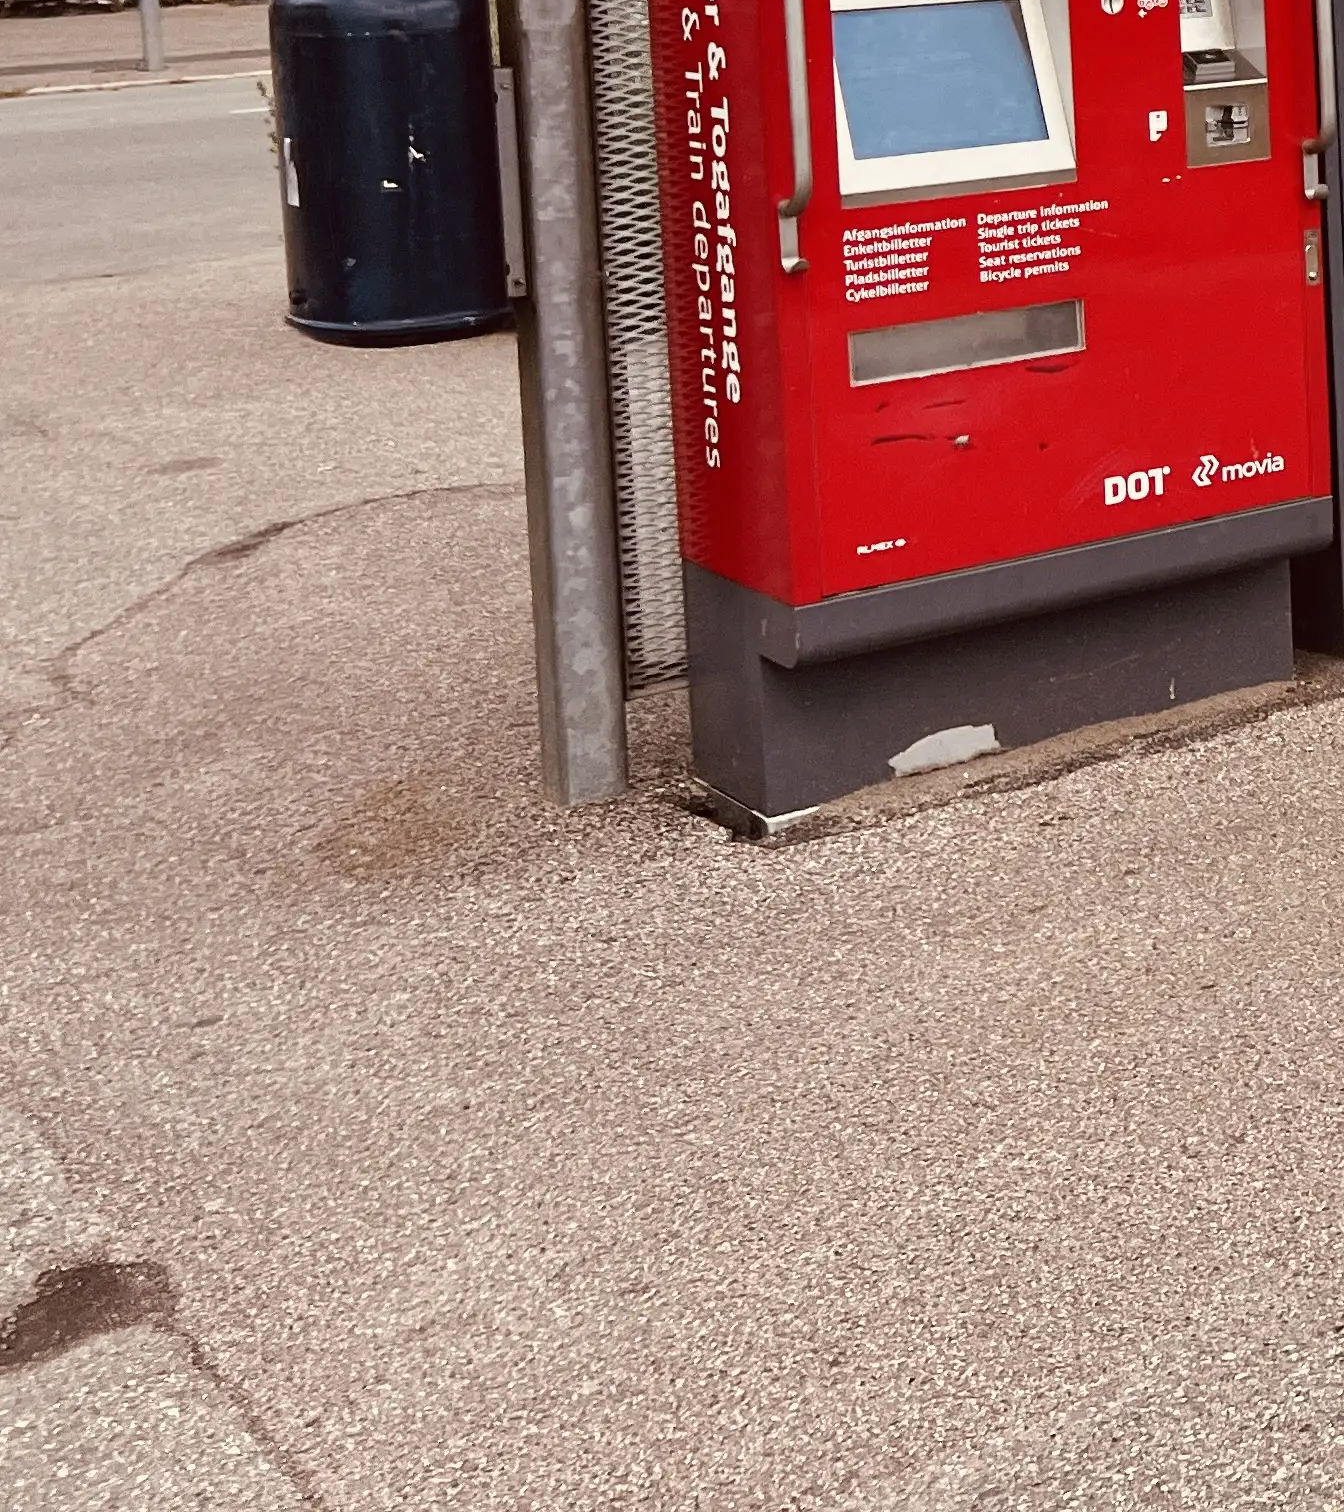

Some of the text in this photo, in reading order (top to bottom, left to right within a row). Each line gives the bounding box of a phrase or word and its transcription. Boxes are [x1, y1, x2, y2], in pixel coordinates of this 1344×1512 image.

[682, 7, 700, 42] &
[708, 42, 726, 81] &
[684, 62, 704, 181] Train
[977, 199, 1109, 228] Departure information
[843, 216, 967, 243] Afgangsinformation
[977, 216, 1080, 240] Single trip tickets
[710, 97, 741, 404] Togafgange
[843, 235, 933, 257] Enkeltbilletter
[978, 232, 1062, 254] Tourist tickets
[979, 244, 1081, 269] Seat reservations
[844, 251, 929, 272] Turistbilletter
[979, 260, 1070, 284] Bicycle permits
[844, 265, 930, 287] Pladsbilletter
[845, 279, 930, 303] Cykelbilletter
[692, 201, 720, 468] departures
[1221, 452, 1285, 482] movia
[1104, 466, 1170, 506] DOT
